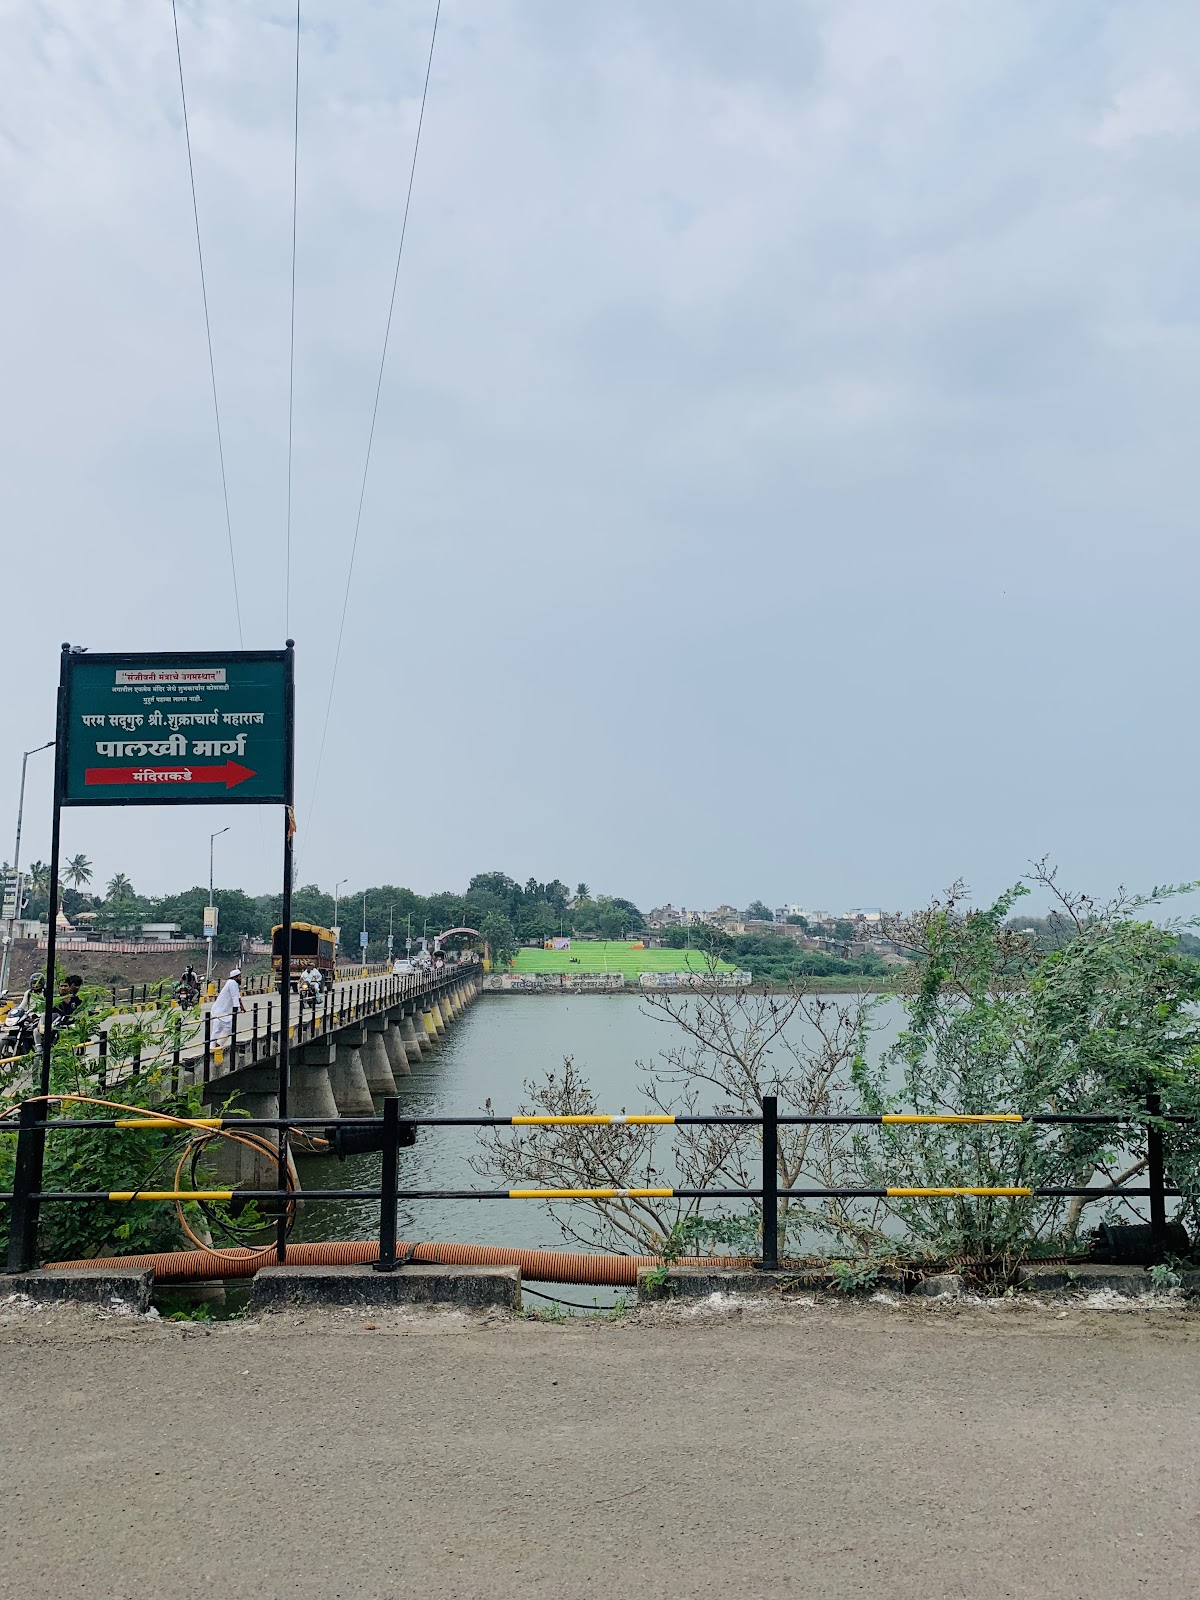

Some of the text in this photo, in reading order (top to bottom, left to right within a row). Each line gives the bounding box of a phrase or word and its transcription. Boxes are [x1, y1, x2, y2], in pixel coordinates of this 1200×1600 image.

[152, 684, 165, 692] मंदिर
[81, 714, 106, 727] परम
[222, 712, 265, 727] महाराज
[95, 733, 248, 758] पालखी मार्ग
[131, 767, 193, 782] मंदिराकडे
